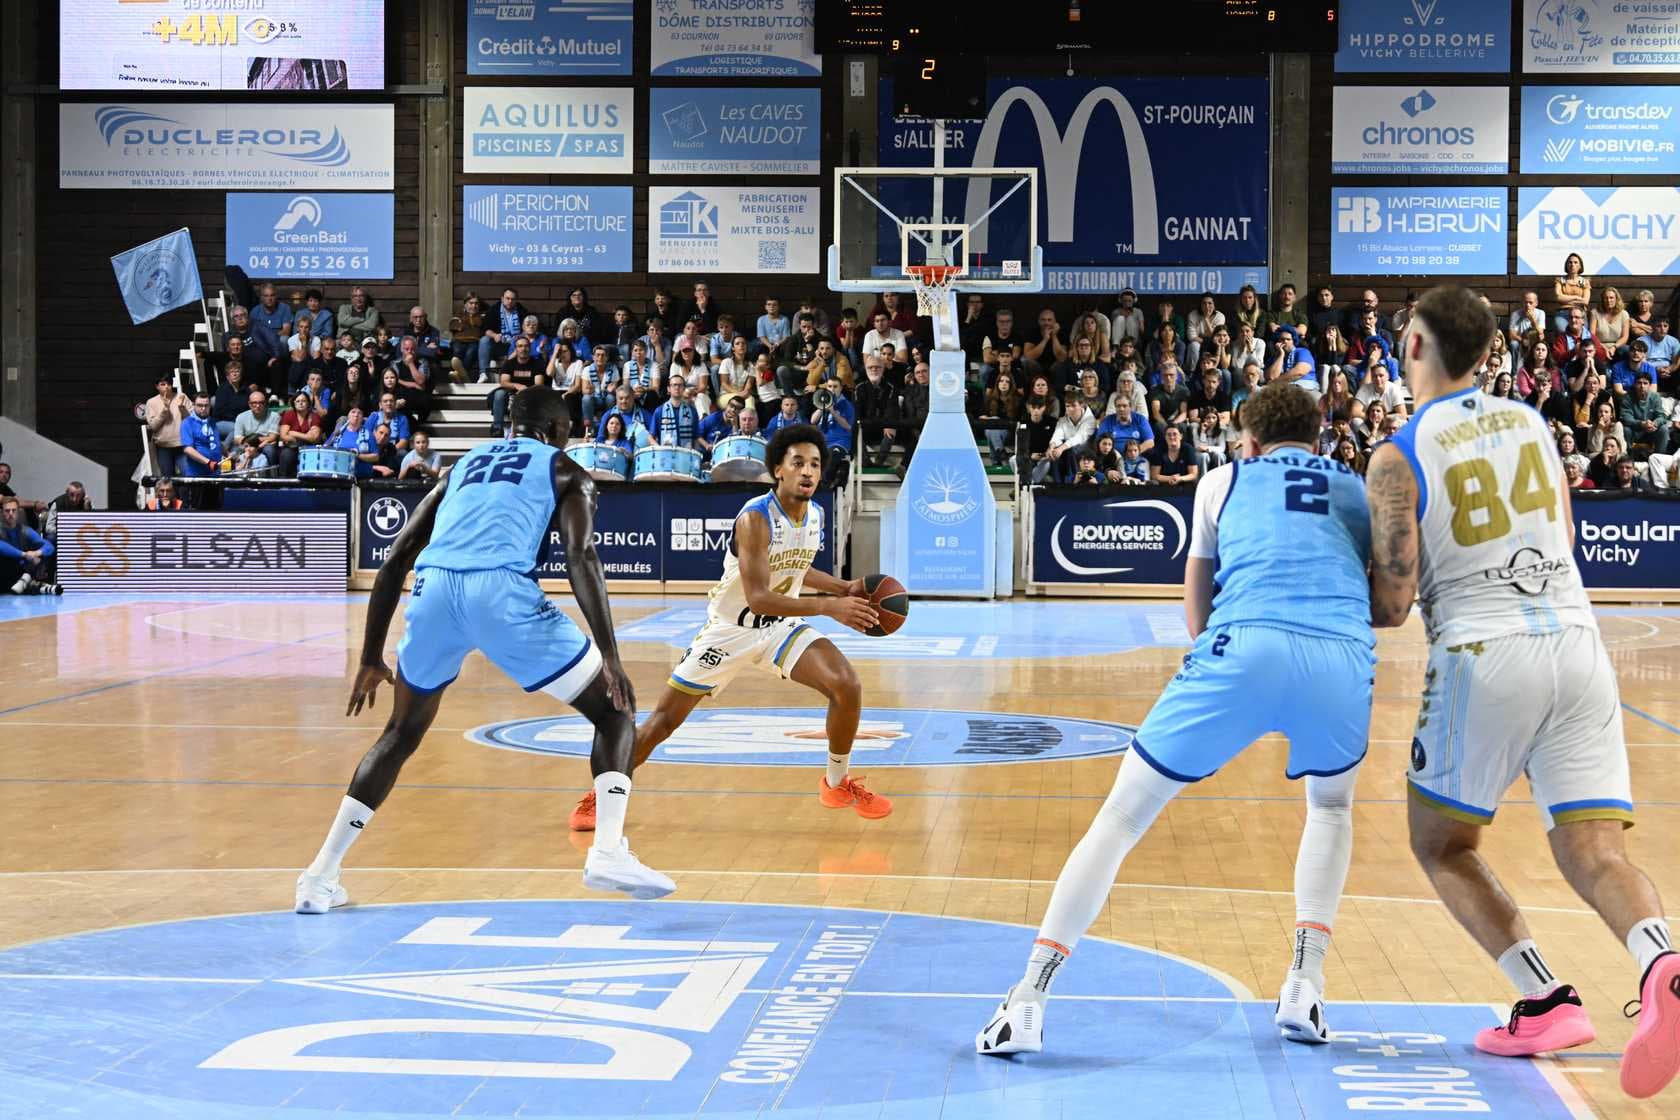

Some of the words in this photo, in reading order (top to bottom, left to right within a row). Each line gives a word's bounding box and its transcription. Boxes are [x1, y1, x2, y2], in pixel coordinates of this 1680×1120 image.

[691, 0, 784, 11] TRANSPORTS
[1613, 3, 1630, 13] de
[659, 13, 701, 28] DÔME
[705, 15, 815, 28] DISTRIBUTION
[1626, 24, 1679, 35] Matériel
[478, 38, 535, 55] Crédit
[559, 39, 621, 55] Mutuel
[892, 40, 900, 50] 9
[1350, 34, 1496, 47] HIPPODROME
[1610, 36, 1626, 46] de
[709, 56, 763, 65] LOGISTIQUE
[1360, 49, 1401, 58] VICHY
[1409, 49, 1486, 58] BELLERIVE
[675, 66, 730, 74] TRANSPORTS
[732, 67, 799, 75] FRIGORIFIQUES
[922, 59, 936, 80] 2
[479, 103, 619, 128] AQUILUS
[719, 104, 746, 120] Les
[750, 103, 804, 121] CAVES
[1143, 105, 1255, 129] ST-POURÇAIN
[1584, 103, 1673, 120] transdev
[124, 129, 321, 145] DUCLEROIR
[719, 126, 808, 144] NAUDOT
[893, 129, 966, 149] s/ALLER
[1362, 121, 1475, 145] chronos
[478, 138, 552, 153] PISCINES
[574, 139, 619, 153] SPAS
[61, 169, 105, 177] PANNEAUX
[751, 162, 809, 172] SOMMELIER
[504, 193, 590, 211] PERICHON
[738, 194, 808, 203] FABRICATION
[1388, 196, 1501, 209] IMPRIMERIE
[742, 205, 805, 213] MENUISERIE
[504, 215, 628, 232] ARCHITECTURE
[756, 216, 780, 224] BOIS
[1387, 213, 1501, 233] H.BRUN
[1538, 211, 1676, 240] ROUCHY
[730, 226, 763, 235] MIXTE
[765, 226, 815, 235] BOIS-ALU
[1164, 216, 1252, 241] GANNAT
[274, 231, 348, 244] GreenBati
[489, 244, 516, 255] Vichy
[526, 244, 540, 254] 03
[551, 244, 584, 256] Ceyrat
[594, 245, 608, 254] 63
[249, 256, 270, 269] 04
[275, 256, 295, 269] 70
[301, 256, 320, 269] 55
[325, 256, 346, 269] 26
[350, 256, 368, 269] 61
[512, 257, 524, 265] 04
[527, 257, 539, 265] 73
[556, 257, 569, 265] 93
[571, 257, 584, 265] 93
[1377, 256, 1392, 265] 04
[1395, 256, 1410, 265] 70
[1049, 271, 1136, 290] RESTAURANT
[1138, 271, 1155, 290] LE
[1157, 271, 1198, 290] PATIO
[456, 452, 533, 492] 22
[1284, 468, 1330, 516] 2
[1444, 441, 1558, 547] 84
[1072, 525, 1165, 541] BOUYGUES
[150, 533, 307, 569] ELSAN
[1581, 544, 1640, 566] Vichy
[604, 560, 652, 574] MEUBLÉES
[1211, 633, 1232, 657] 2
[719, 985, 843, 1084] CONFIANCE
[1331, 1064, 1492, 1113] BAC
